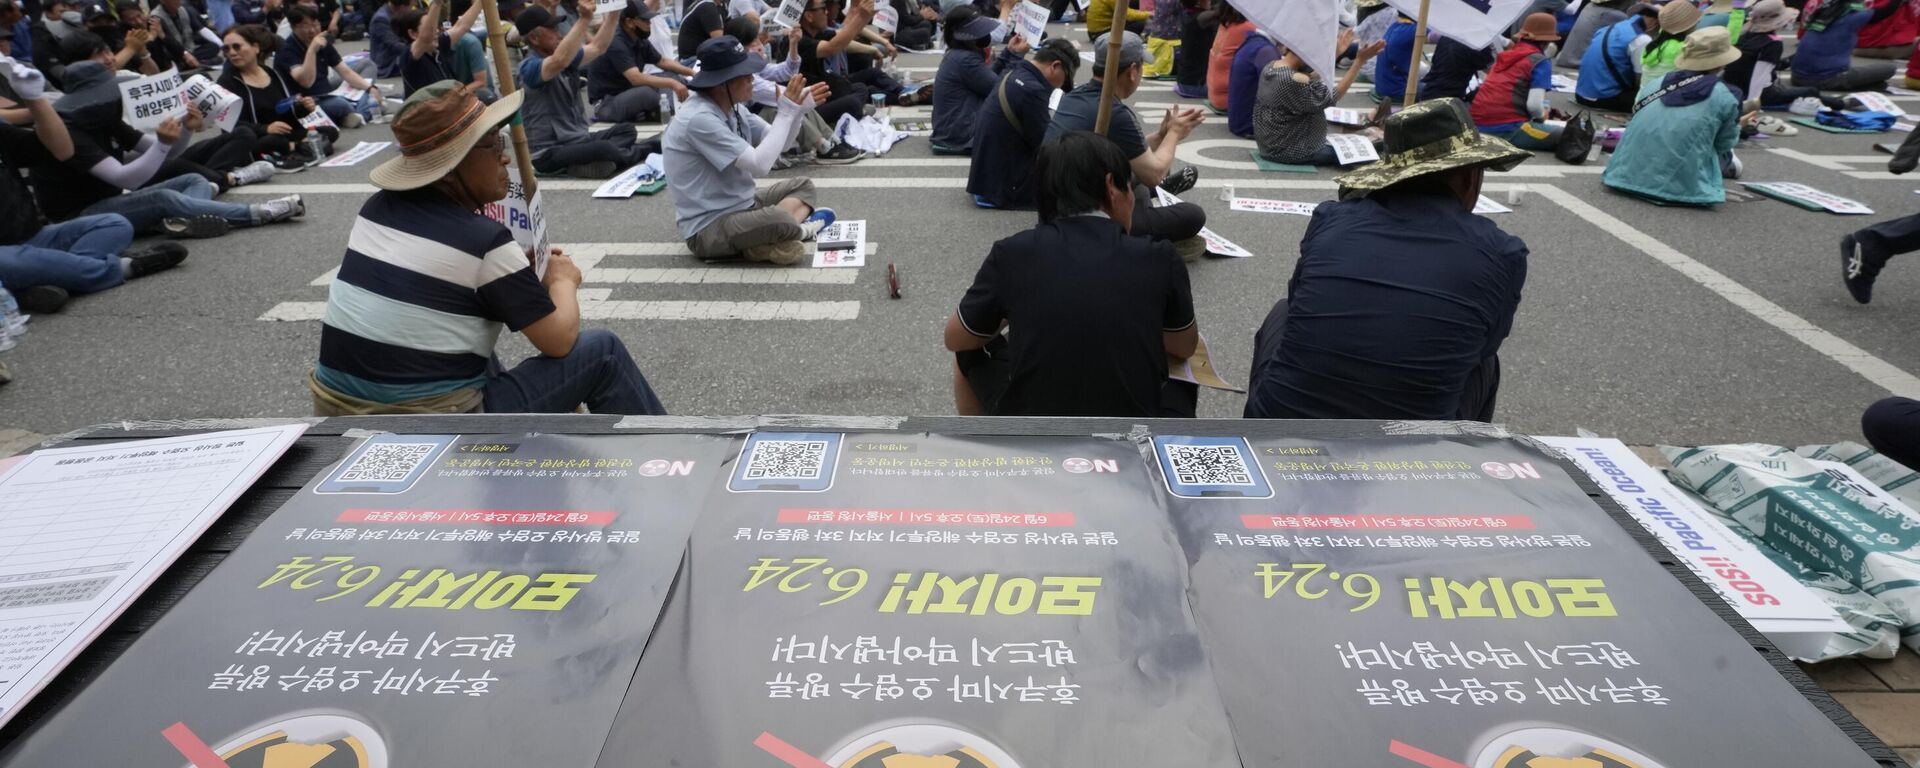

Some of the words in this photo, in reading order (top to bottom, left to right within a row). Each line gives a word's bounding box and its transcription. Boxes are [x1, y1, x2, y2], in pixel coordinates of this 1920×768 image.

[128, 79, 173, 99] 후쿠시마
[135, 93, 182, 119] 해양투기
[510, 207, 531, 231] Pa
[1575, 447, 1646, 493] Ocean!
[365, 510, 395, 522] 동편
[397, 511, 446, 522] 서울시청
[458, 511, 481, 523] 5시
[483, 511, 510, 523] 오후
[512, 511, 563, 523] 24일(토)
[565, 511, 588, 523] 6월
[808, 511, 835, 522] 동편
[839, 511, 893, 522] 서울시청
[909, 512, 933, 523] 5시
[936, 512, 963, 524] 오후
[966, 513, 1021, 524] 24일(토)
[1024, 513, 1047, 525] 6월
[1272, 516, 1300, 527] 동편
[1302, 516, 1356, 527] 서울시청
[1372, 517, 1395, 528] 5시
[1399, 517, 1425, 528] 오후
[1428, 517, 1482, 528] 24일(토)
[1484, 517, 1507, 528] 6월
[1635, 497, 1717, 551] Pacific
[286, 528, 305, 540] 날
[309, 528, 355, 541] 행동의
[360, 528, 384, 542] 3차
[388, 528, 422, 542] 저지
[428, 528, 493, 543] 해양투기
[497, 529, 549, 544] 오염수
[552, 529, 602, 544] 방사성
[605, 529, 640, 544] 일본
[735, 527, 753, 542] 날
[758, 528, 810, 542] 행동의
[815, 529, 844, 542] 3차
[849, 529, 884, 543] 저지
[890, 530, 960, 544] 해양투기
[965, 531, 1019, 545] 오염수
[1024, 531, 1078, 545] 방사성
[1081, 531, 1118, 545] 일본
[1213, 533, 1233, 547] 날
[1237, 534, 1288, 548] 행동의
[1294, 534, 1322, 548] 3차
[1328, 534, 1363, 548] 저지
[1368, 534, 1439, 548] 해양투기
[1443, 534, 1495, 548] 오염수
[1500, 534, 1552, 548] 방사성
[1554, 534, 1591, 548] 일본
[257, 556, 381, 602] 6.24
[743, 557, 868, 606] 6.24
[1701, 556, 1781, 608] SOS!!
[366, 567, 596, 611] 모이자!
[878, 572, 1102, 615] 모이자!
[1254, 562, 1380, 612] 6.24
[1405, 576, 1618, 619] 모이자!
[237, 629, 410, 658] 막아냅시다!
[418, 631, 515, 660] 반드시
[772, 635, 959, 664] 막아냅시다!
[970, 638, 1075, 667] 반드시
[1334, 641, 1525, 670] 막아냅시다!
[1525, 641, 1639, 671] 반드시
[208, 664, 269, 691] 방류
[277, 666, 372, 693] 오염수
[372, 666, 498, 696] 후쿠시마
[765, 673, 829, 700] 방류
[840, 673, 939, 702] 오염수
[948, 674, 1080, 704] 후쿠시마
[1356, 680, 1423, 706] 방류
[1430, 679, 1523, 705] 오염수
[1536, 677, 1669, 705] 후쿠시마
